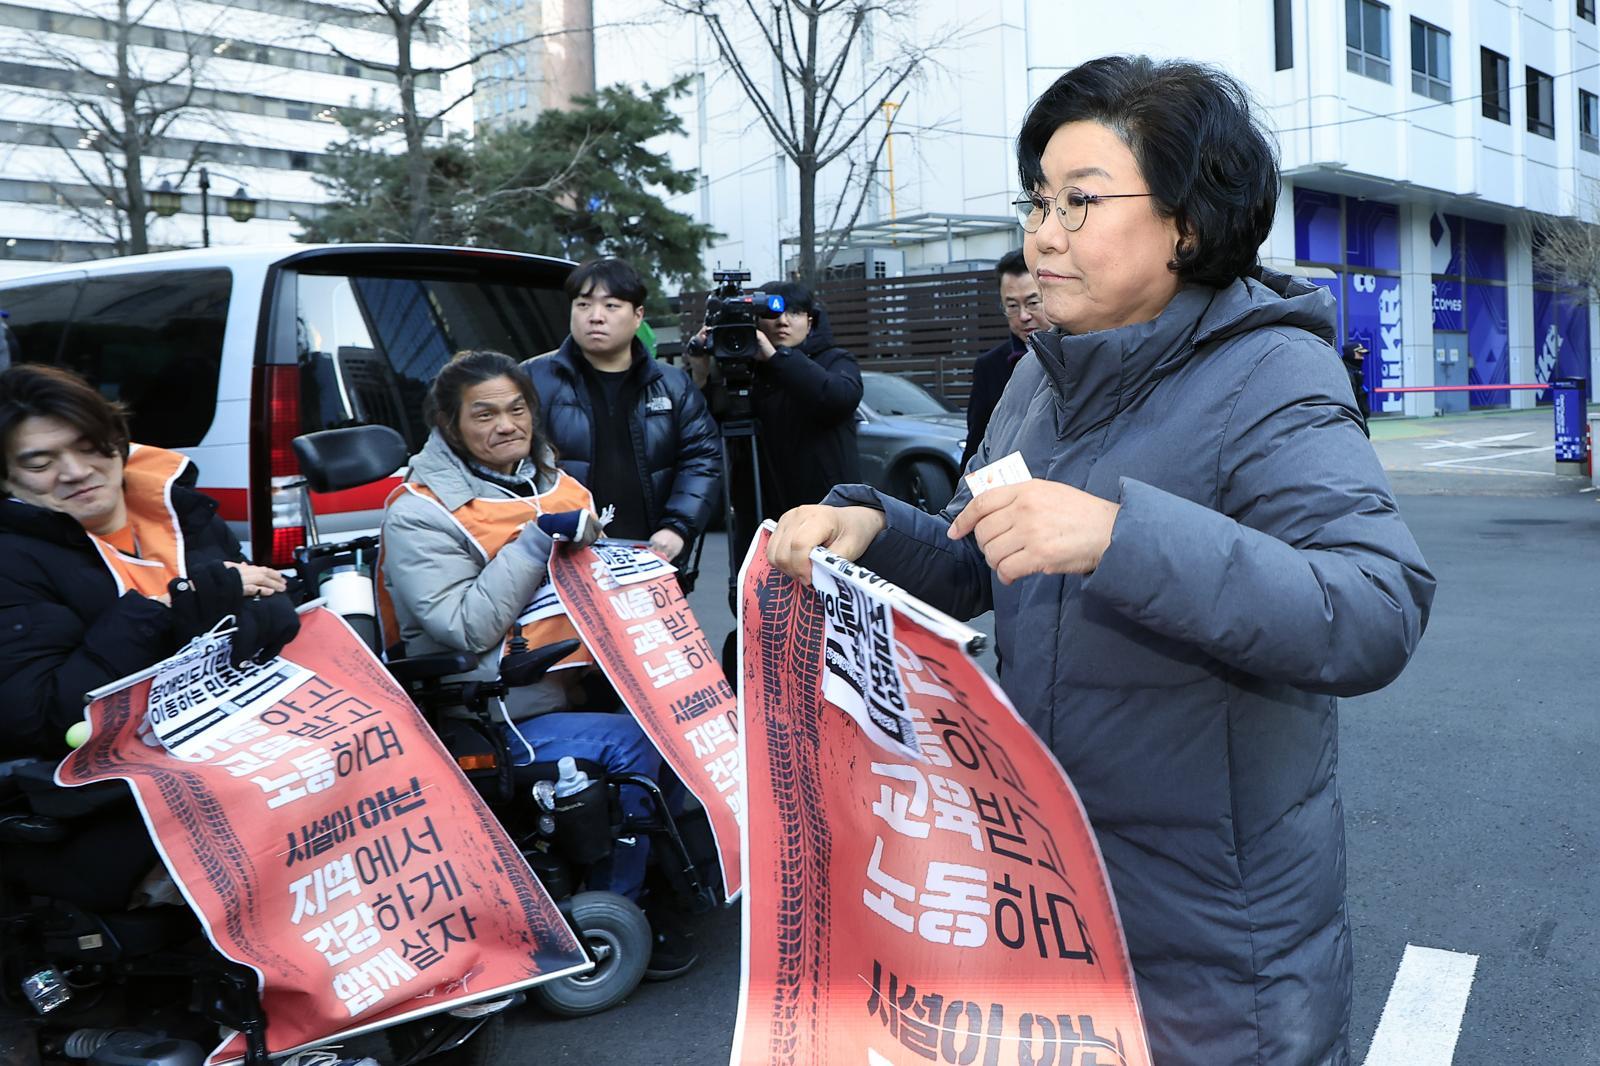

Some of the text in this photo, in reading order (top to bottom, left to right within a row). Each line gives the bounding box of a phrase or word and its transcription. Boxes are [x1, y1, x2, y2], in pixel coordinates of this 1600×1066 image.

[772, 299, 781, 309] A
[1430, 298, 1462, 312] COMES
[626, 606, 700, 655] 교육받
[151, 688, 208, 724] 이동하는
[208, 697, 382, 777] 교육받고
[670, 685, 722, 725] 시설이
[250, 721, 404, 809] 노동하며
[286, 777, 426, 867] 시설이 아닌
[871, 761, 1076, 894] 교육받고
[287, 817, 444, 925] 지역에서
[302, 861, 462, 967] 건강하게
[867, 959, 1004, 1066] 시설이
